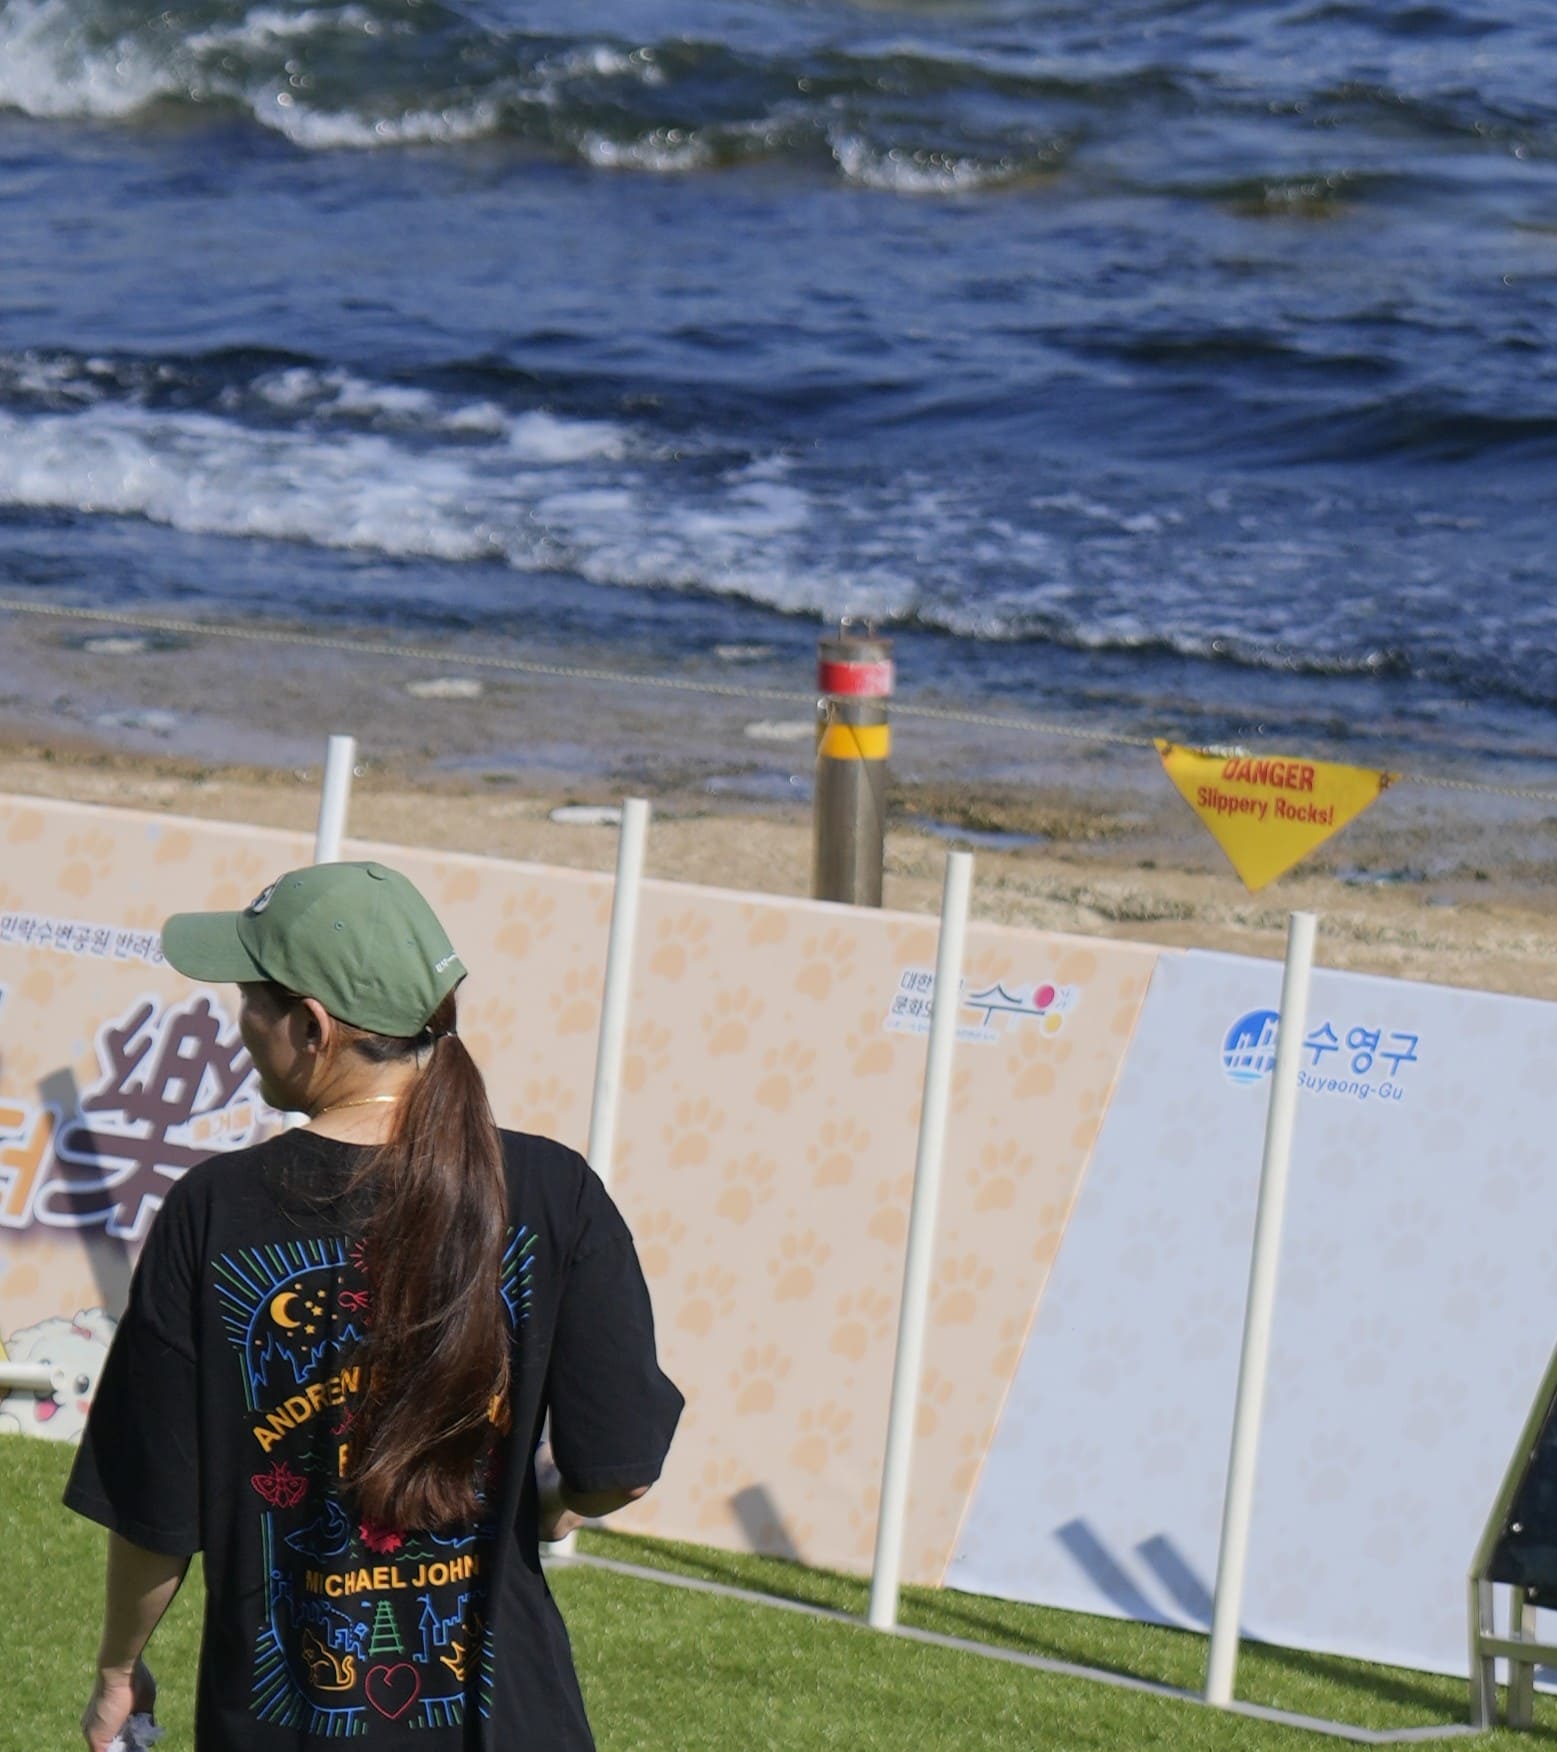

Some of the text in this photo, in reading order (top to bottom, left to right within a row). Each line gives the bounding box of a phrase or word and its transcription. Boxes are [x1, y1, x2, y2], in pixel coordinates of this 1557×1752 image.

[1196, 787, 1335, 826] Slippery Rocks!
[1303, 1022, 1419, 1076] 수영구
[306, 1566, 406, 1597] MICHAEL
